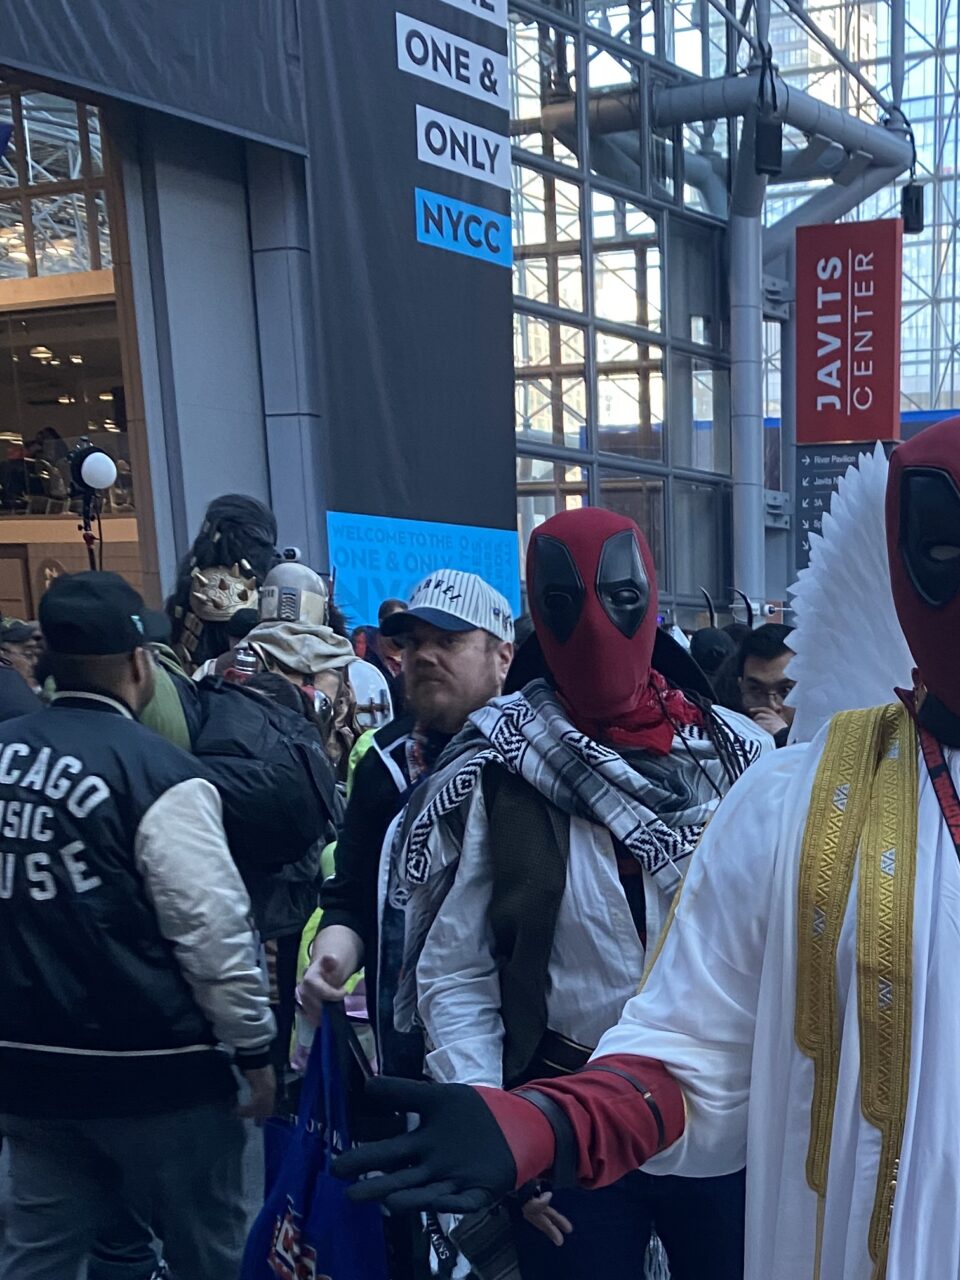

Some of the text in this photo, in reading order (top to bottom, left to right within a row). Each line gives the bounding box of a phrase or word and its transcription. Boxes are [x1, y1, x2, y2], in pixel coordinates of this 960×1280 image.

[405, 29, 499, 96] ONE &
[424, 120, 500, 175] ONLY
[422, 198, 501, 254] NYCC
[816, 256, 843, 411] JAVITS
[853, 251, 874, 411] CENTER
[831, 454, 856, 463] Pavilion
[332, 524, 453, 549] WELCOME TO THE
[334, 546, 380, 571] ONE
[386, 551, 401, 572] &
[0, 742, 111, 818] CAGO
[0, 800, 54, 842] SIC
[0, 840, 102, 901] USE
